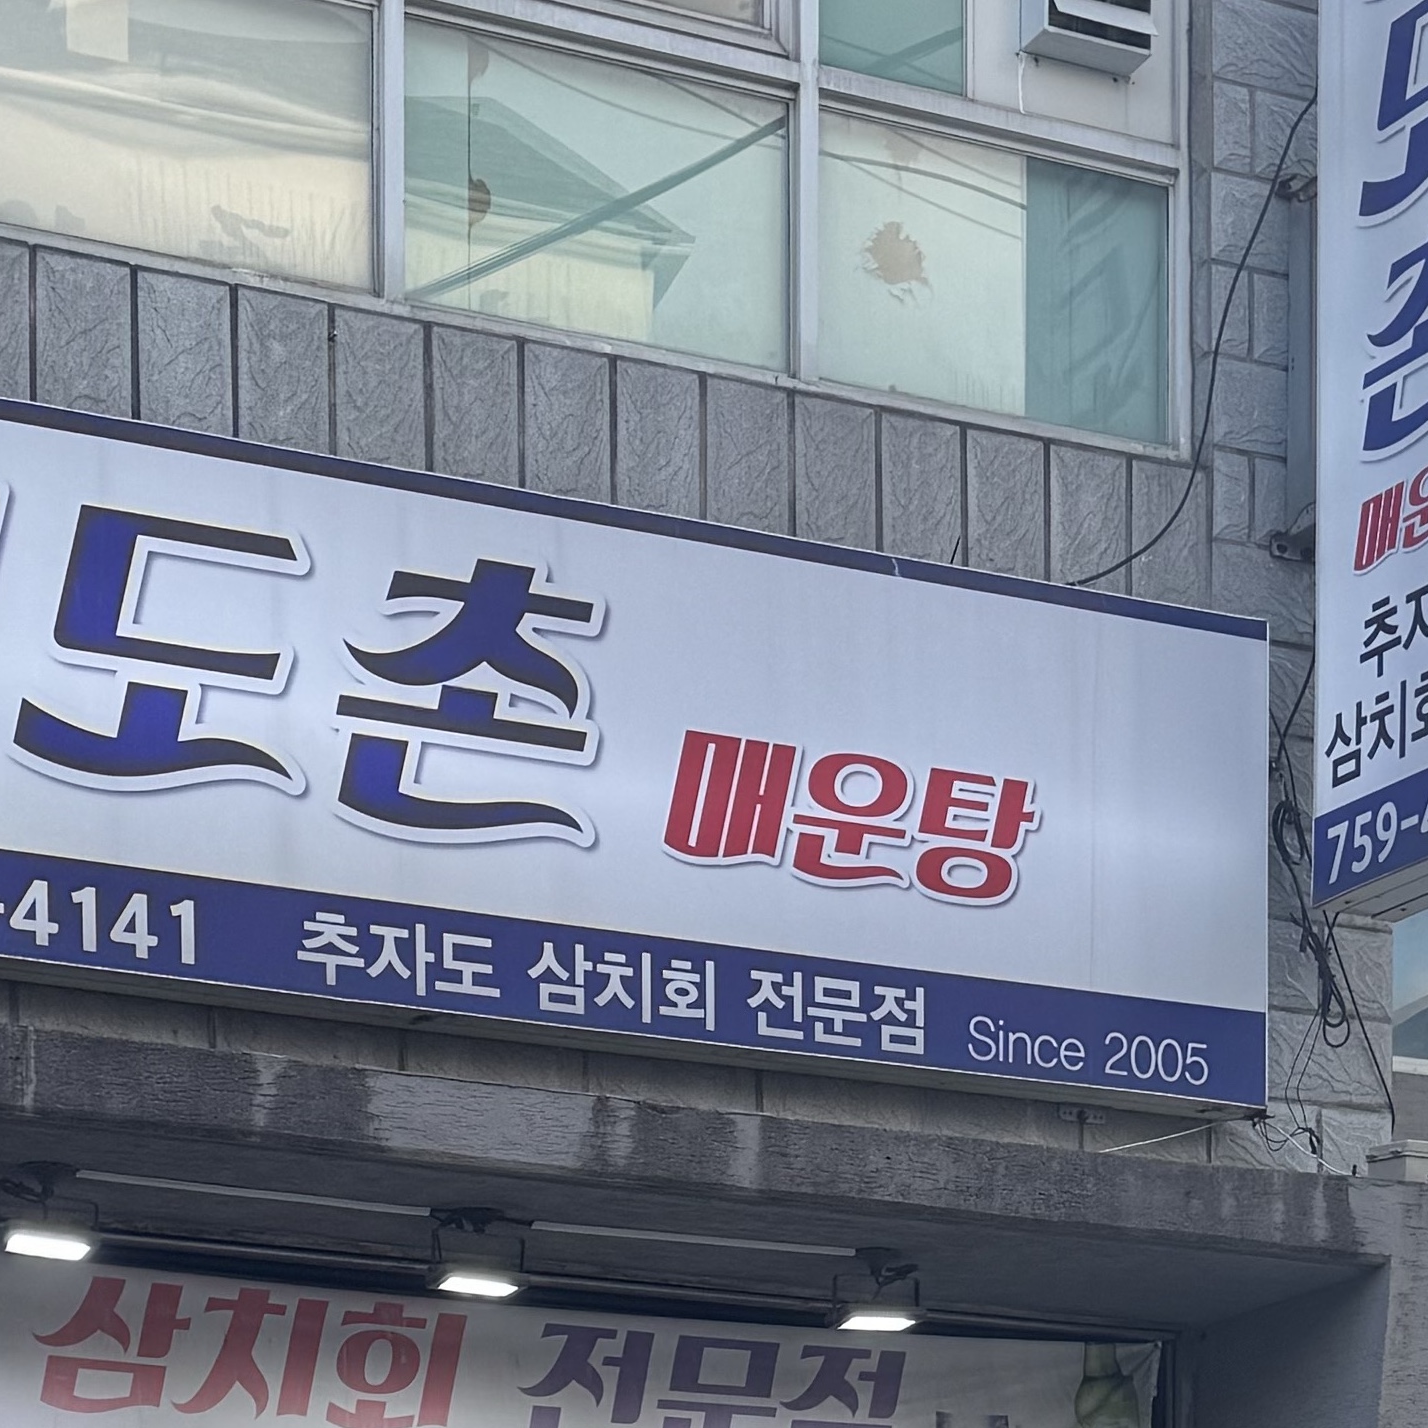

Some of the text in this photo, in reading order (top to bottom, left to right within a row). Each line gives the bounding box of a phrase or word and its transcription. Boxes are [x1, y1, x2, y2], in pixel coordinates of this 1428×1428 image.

[666, 730, 1036, 903] 매운탕
[298, 912, 927, 1056] 추자도 삼치회 전문점
[969, 1016, 1209, 1086] Since 2005
